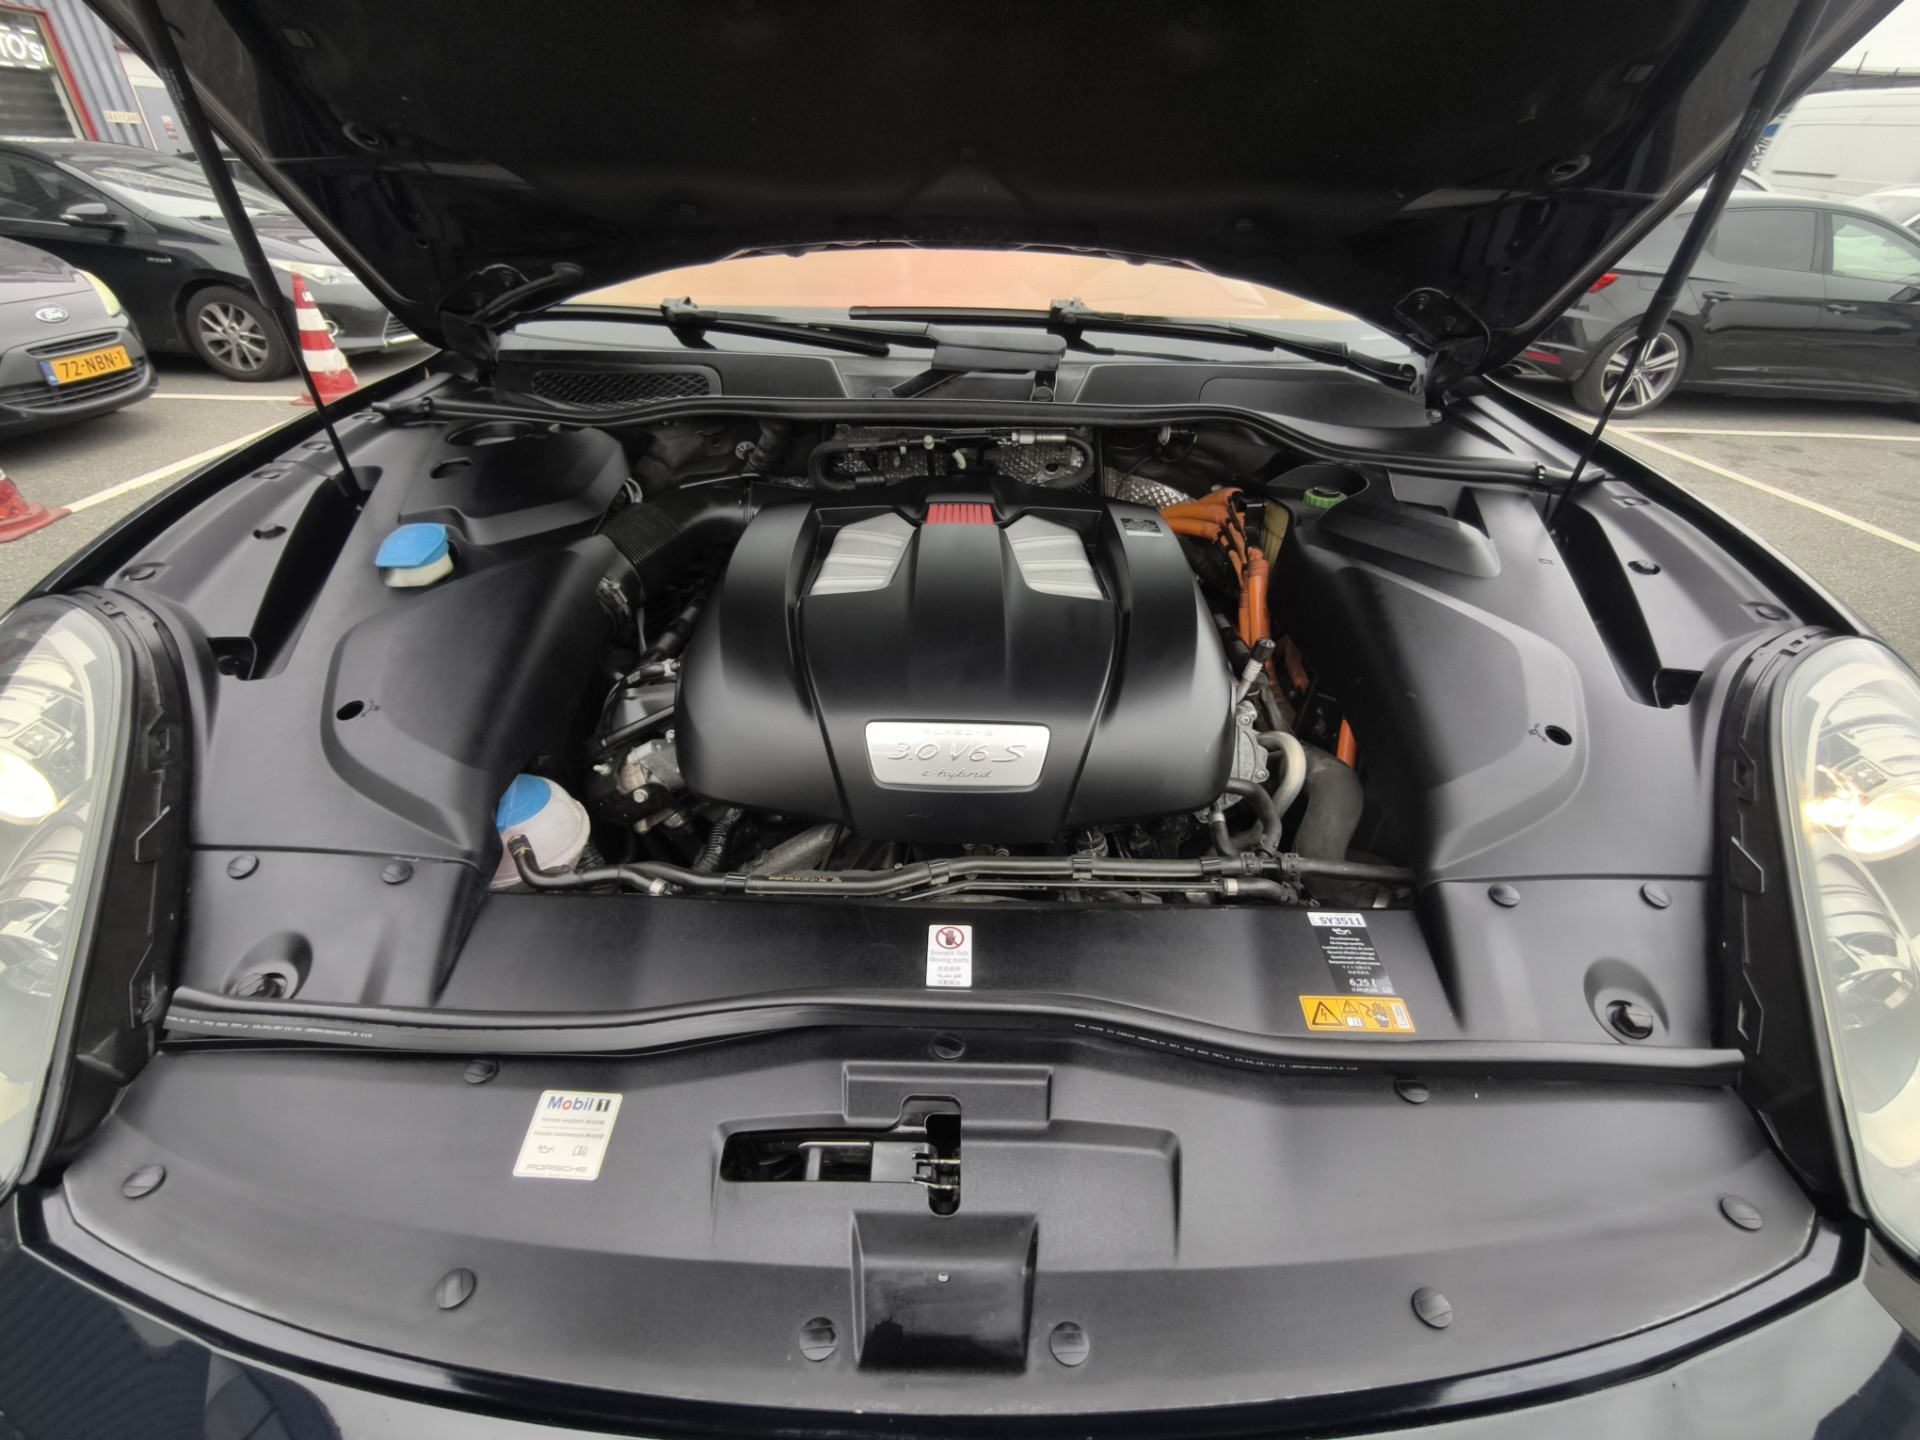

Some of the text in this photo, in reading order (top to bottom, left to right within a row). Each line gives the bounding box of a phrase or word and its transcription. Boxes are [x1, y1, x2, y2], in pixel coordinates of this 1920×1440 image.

[58, 350, 125, 379] 72-NBN-1
[888, 742, 1027, 763] 3.0 V6 S
[921, 768, 993, 781] e-hybrid
[1319, 916, 1363, 926] SY3511
[929, 956, 952, 964] Moving
[1349, 978, 1370, 987] 6,25
[547, 1096, 612, 1112] Mobil 1
[526, 1164, 589, 1173] PORSCHE
